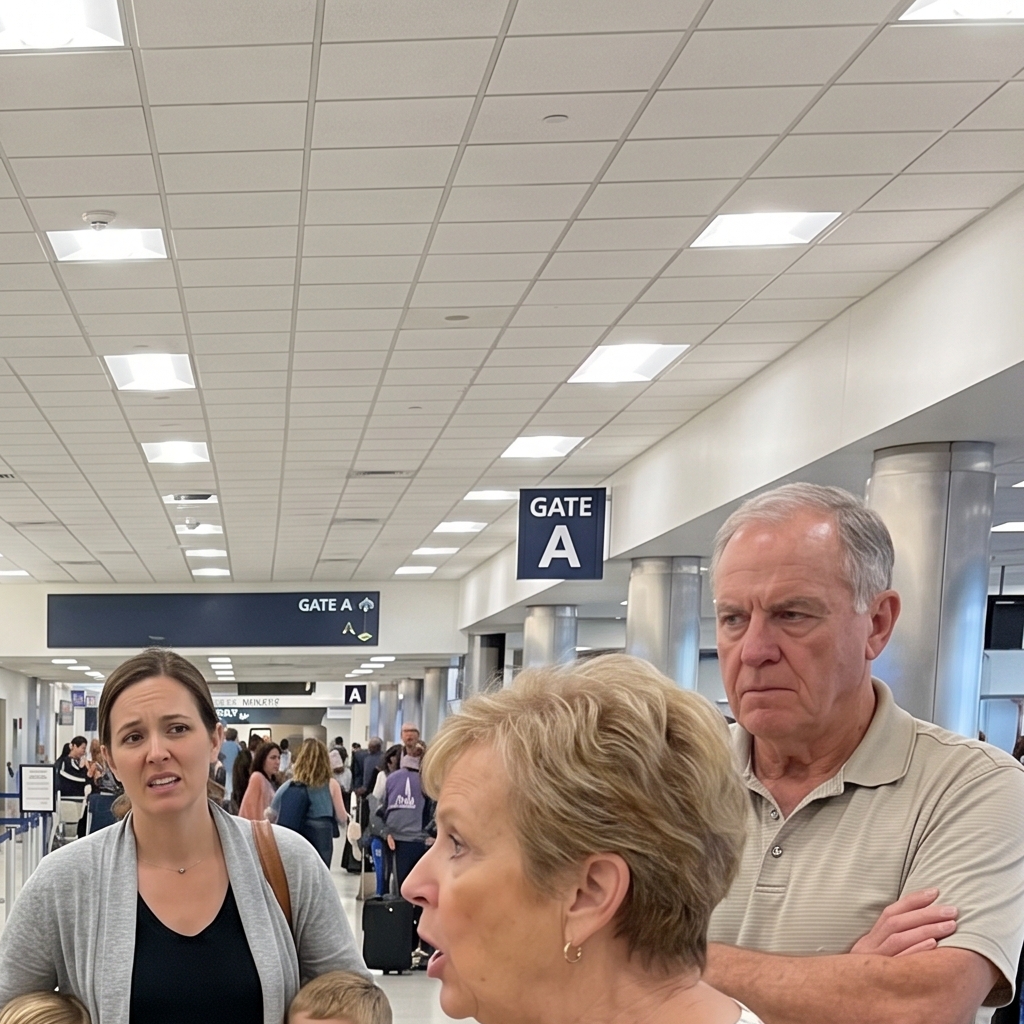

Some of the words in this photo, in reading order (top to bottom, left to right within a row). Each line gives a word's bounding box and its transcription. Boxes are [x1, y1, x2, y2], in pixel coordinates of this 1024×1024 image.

[530, 496, 593, 518] GATE
[538, 525, 581, 568] A
[298, 598, 337, 612] GATE
[340, 598, 353, 611] A
[349, 687, 362, 702] A
